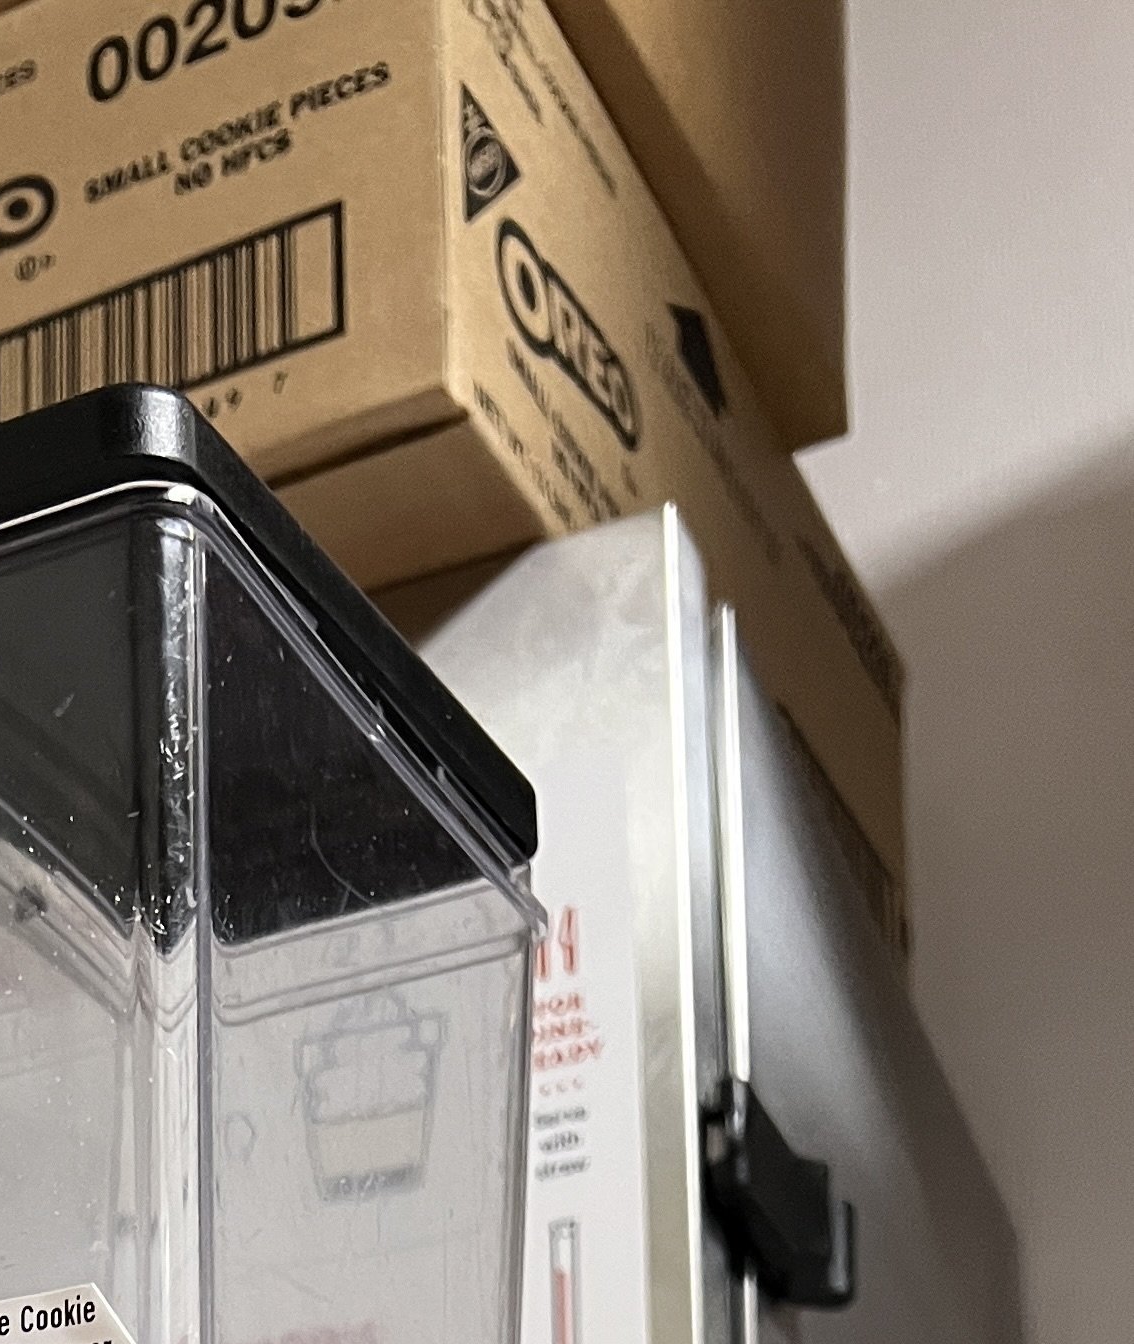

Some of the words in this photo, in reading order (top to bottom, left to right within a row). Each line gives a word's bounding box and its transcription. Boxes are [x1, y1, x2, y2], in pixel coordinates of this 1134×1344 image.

[83, 150, 169, 202] SMALL
[179, 100, 279, 162] COOKIE
[289, 61, 388, 120] PIECES
[173, 161, 212, 196] NO
[21, 1294, 96, 1332] Cookie
